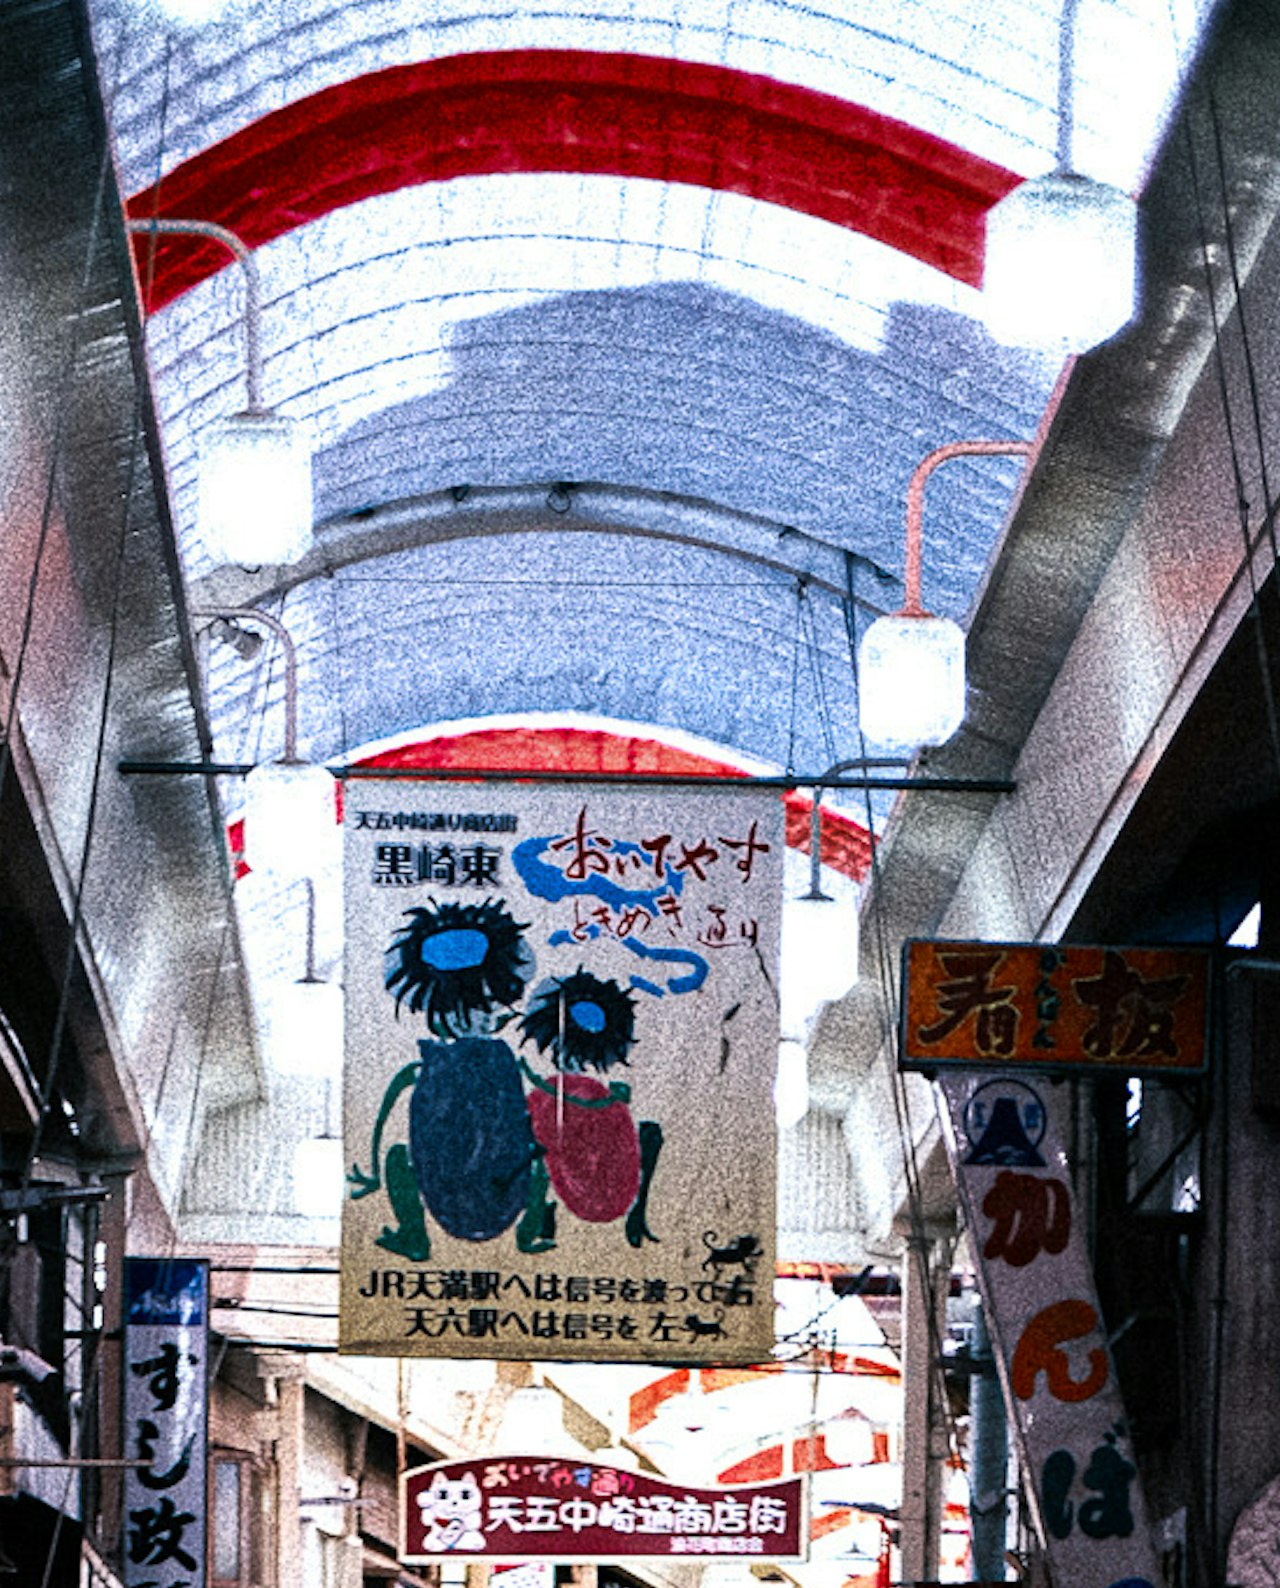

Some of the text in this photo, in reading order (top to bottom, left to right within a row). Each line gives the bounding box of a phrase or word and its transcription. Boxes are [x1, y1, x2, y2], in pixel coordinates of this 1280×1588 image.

[353, 811, 518, 833] 天五中崎通り商店街
[552, 804, 769, 883] おいでやす
[374, 845, 502, 887] 黒崎東
[130, 1342, 197, 1572] すし政
[484, 1496, 788, 1534] 天五中崎通商店街
